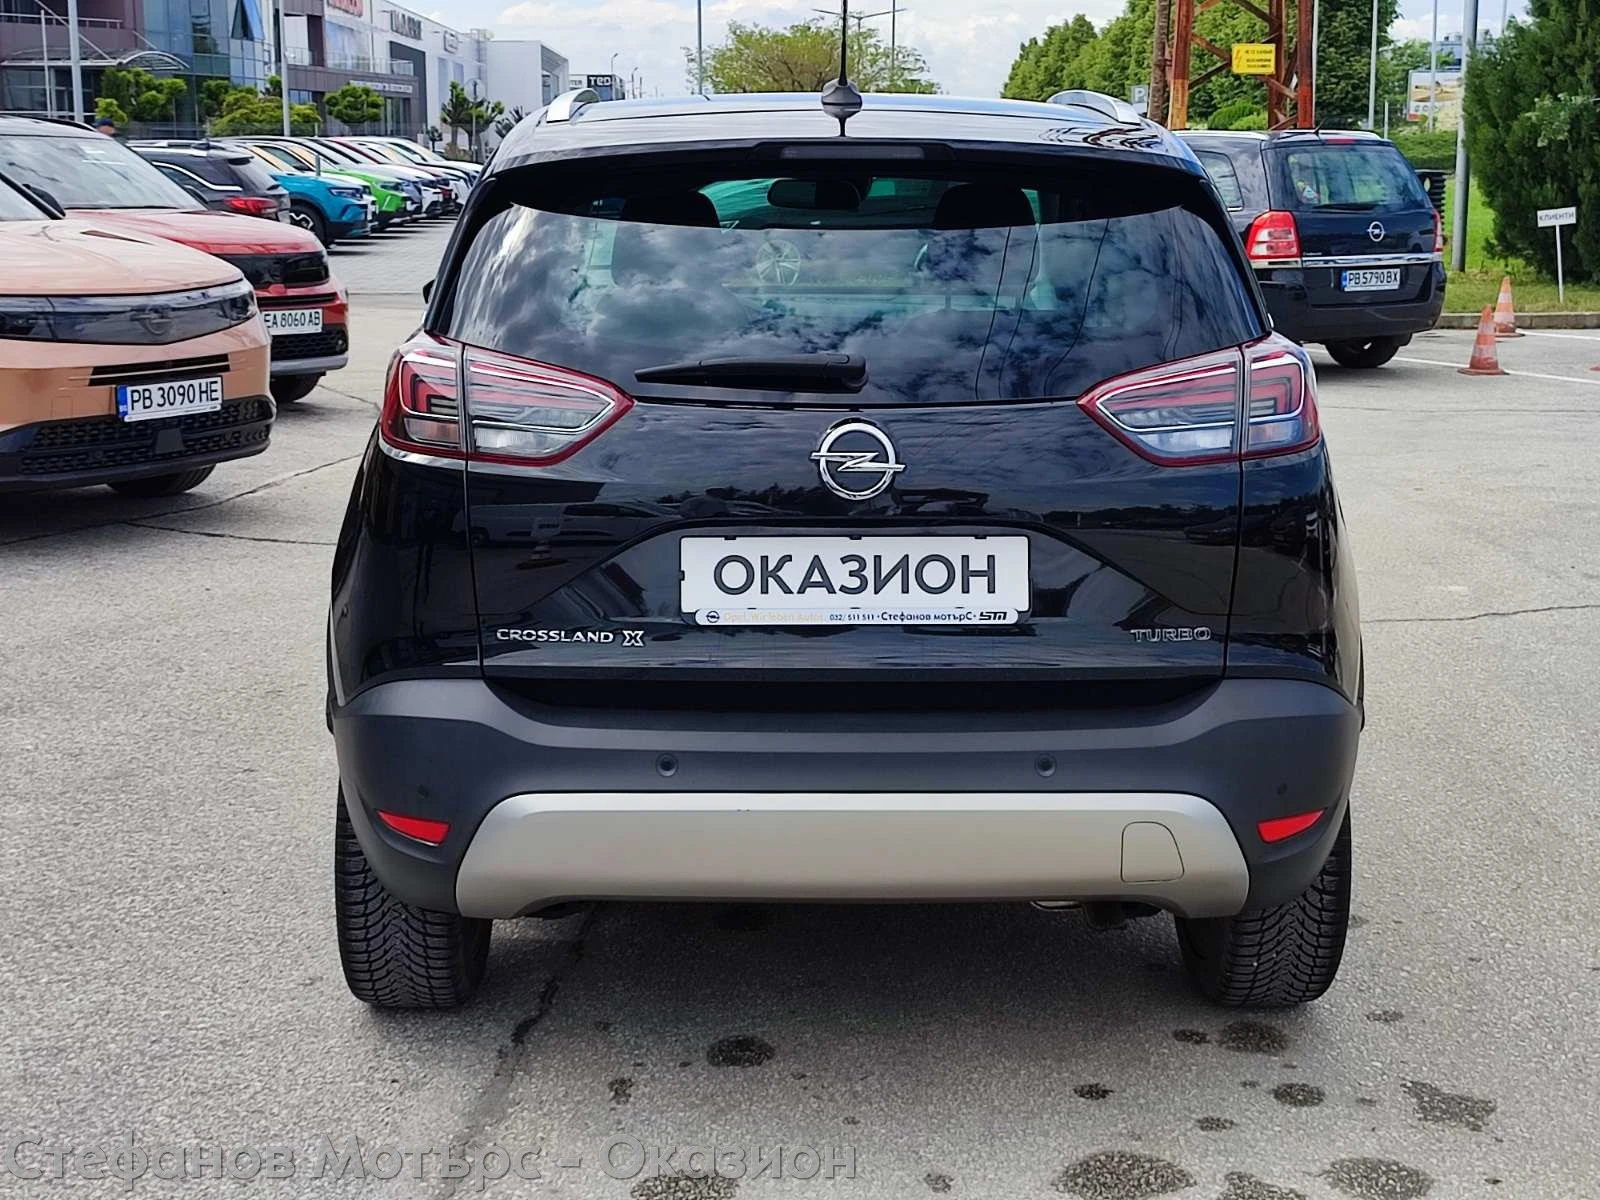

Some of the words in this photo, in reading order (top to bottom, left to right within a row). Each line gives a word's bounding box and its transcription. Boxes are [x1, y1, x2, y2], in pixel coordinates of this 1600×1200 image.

[1362, 271, 1385, 285] 5790
[280, 311, 306, 328] 8060
[308, 310, 321, 326] AB
[130, 388, 153, 411] PB
[157, 383, 196, 407] 3090
[198, 380, 219, 403] HE
[713, 553, 997, 596] ОКАЗИОН
[496, 628, 614, 643] CROSSLAND
[621, 629, 645, 647] X
[1130, 626, 1212, 642] TURBO
